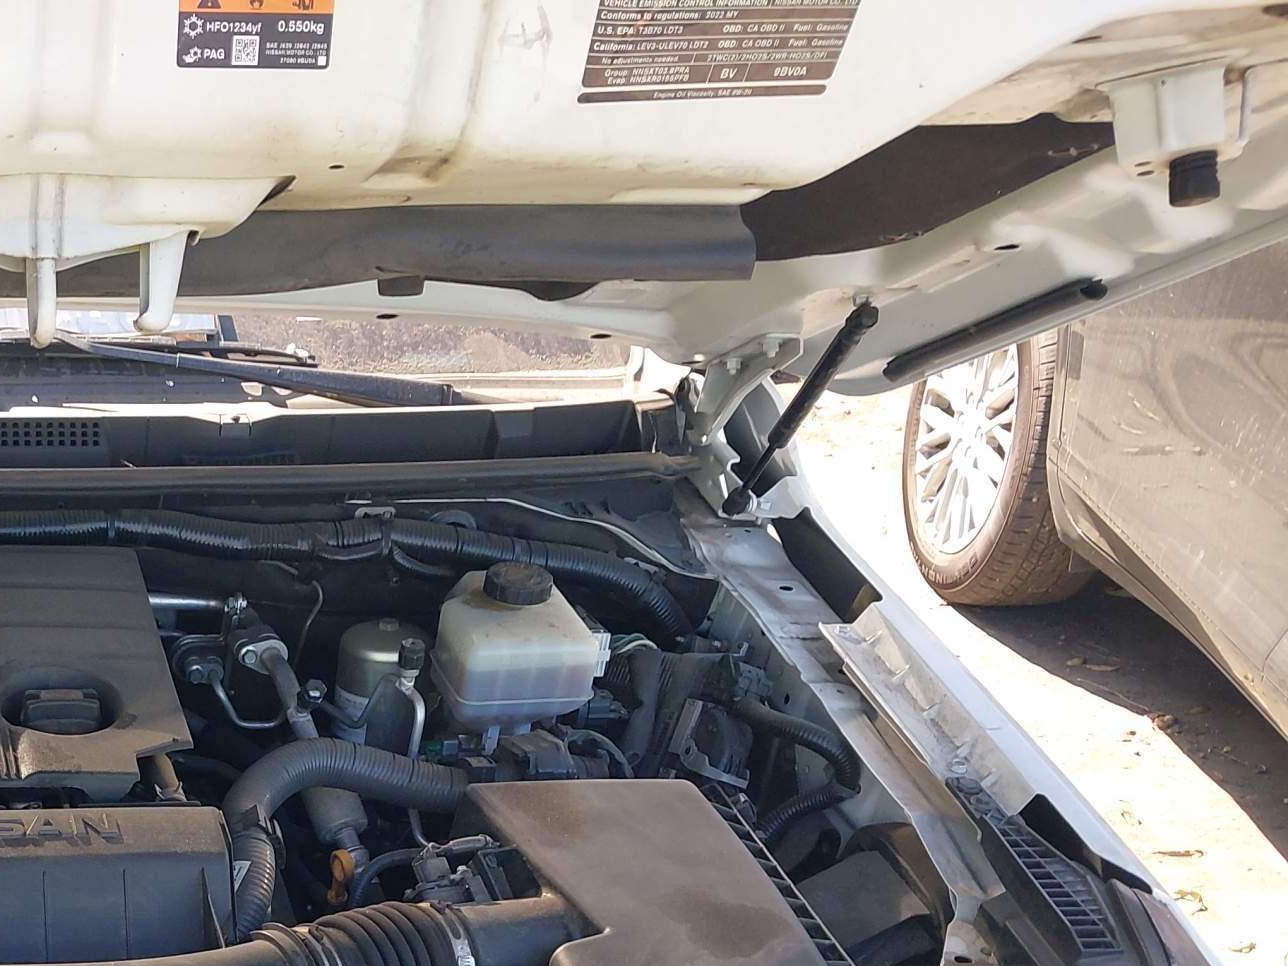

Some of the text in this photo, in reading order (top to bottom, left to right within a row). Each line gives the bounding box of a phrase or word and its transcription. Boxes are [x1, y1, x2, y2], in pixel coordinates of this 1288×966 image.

[601, 10, 642, 20] Conforms
[643, 11, 652, 20] to
[705, 11, 723, 19] 2022
[726, 10, 739, 18] MY
[206, 20, 325, 35] HFO1234yf 0.550kg
[597, 25, 615, 34] U.S.
[747, 23, 758, 32] CA
[760, 23, 778, 32] OBD
[816, 23, 849, 32] Gasoline
[741, 39, 753, 48] CA
[754, 39, 773, 48] OBD
[811, 38, 844, 47] Gasoline
[203, 48, 225, 59] PAG
